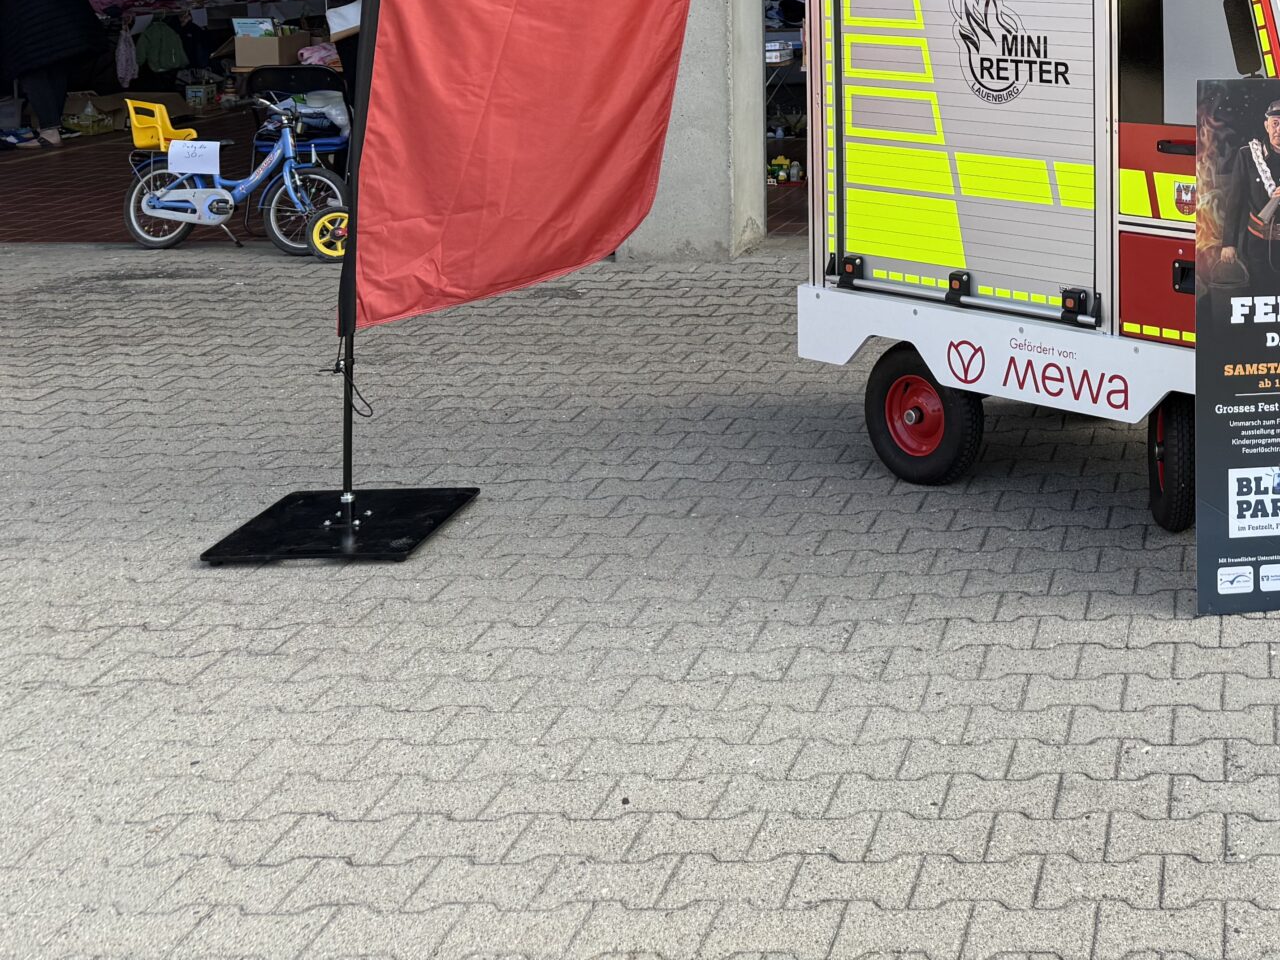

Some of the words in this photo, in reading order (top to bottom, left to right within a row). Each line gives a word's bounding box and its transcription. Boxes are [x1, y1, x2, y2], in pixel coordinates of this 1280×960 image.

[1001, 34, 1048, 59] MINI
[980, 57, 1071, 85] RETTER
[971, 82, 1020, 103] LAUENBURG
[1009, 337, 1055, 356] Gefördert
[1057, 349, 1077, 360] von:
[1258, 379, 1272, 388] ab
[1215, 404, 1255, 414] Grosses
[1258, 402, 1279, 412] Fest
[1247, 523, 1275, 531] Festzelt,
